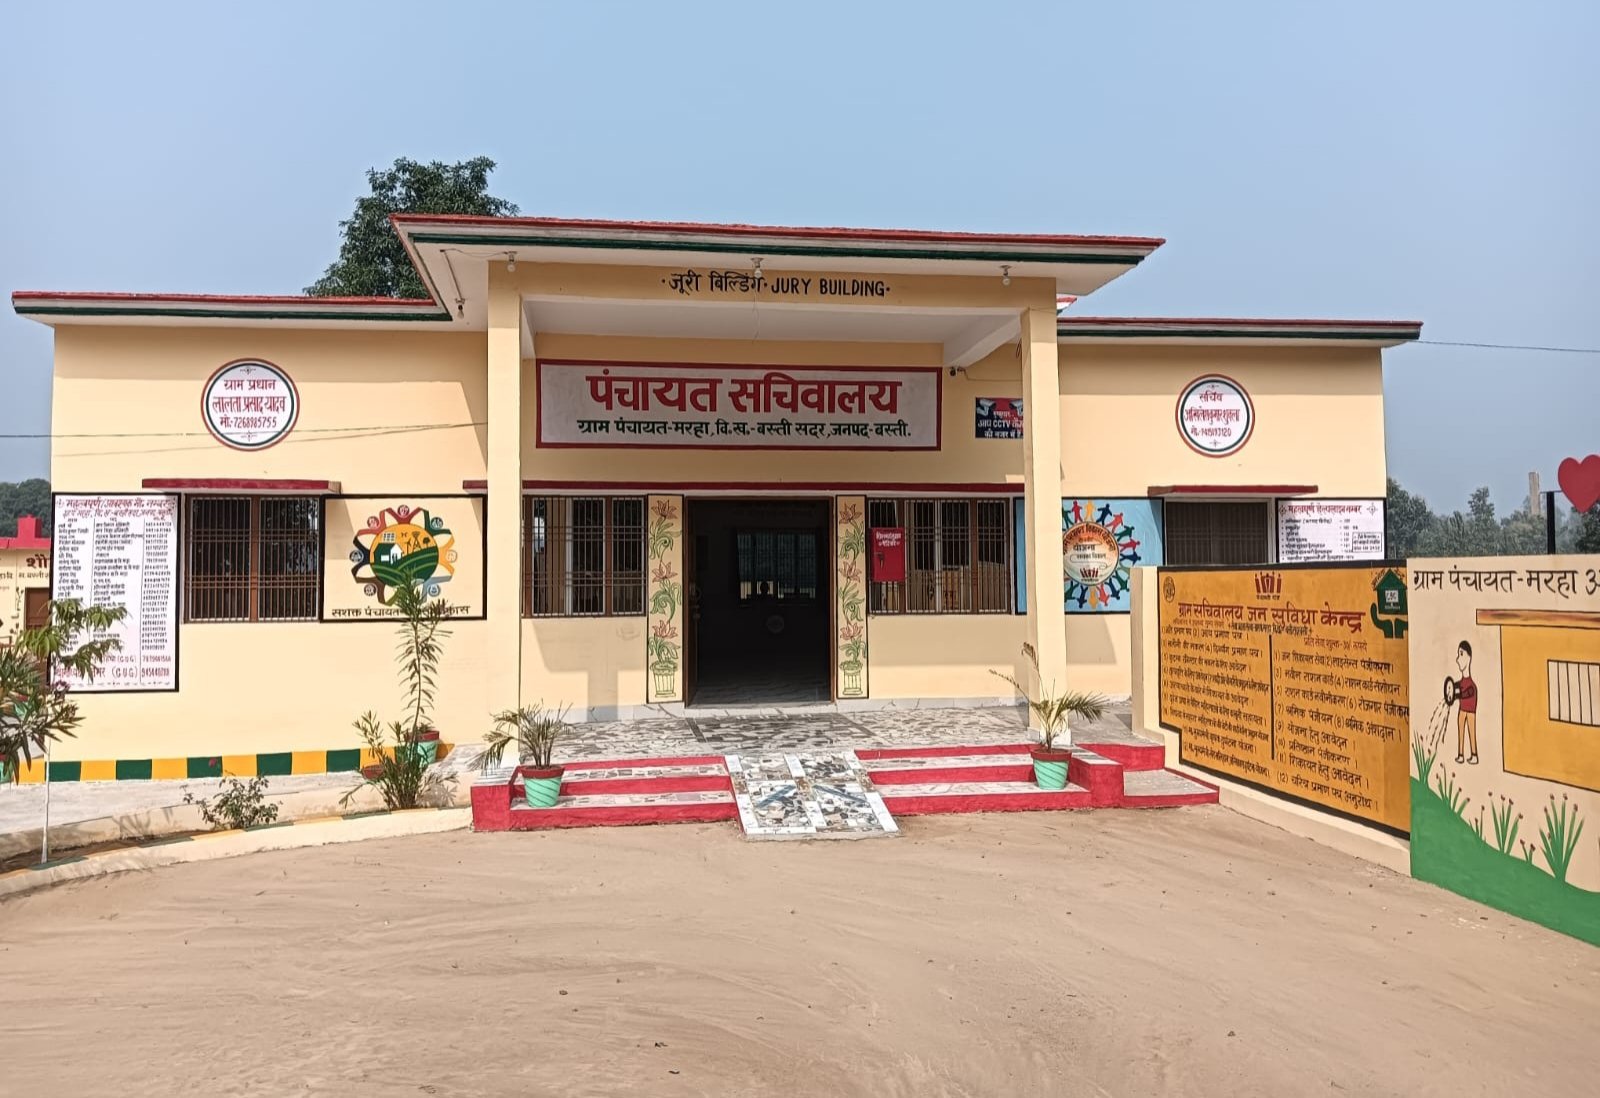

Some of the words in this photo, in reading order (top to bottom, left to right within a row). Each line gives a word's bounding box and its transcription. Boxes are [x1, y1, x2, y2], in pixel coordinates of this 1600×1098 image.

[771, 277, 811, 295] JURY
[819, 279, 884, 297] BUILDING
[224, 379, 245, 391] ग्राम
[247, 379, 276, 391] प्रधान
[585, 368, 723, 412] पंचायत
[728, 372, 902, 414] सचिवालय
[577, 419, 610, 435] ग्राम
[993, 420, 1010, 428] CCTV
[1414, 570, 1444, 590] ग्राम
[1193, 598, 1243, 621] सचिवालय
[1247, 606, 1267, 621] जन
[1271, 601, 1318, 628] सुविधा
[1320, 602, 1366, 633] केन्द्र
